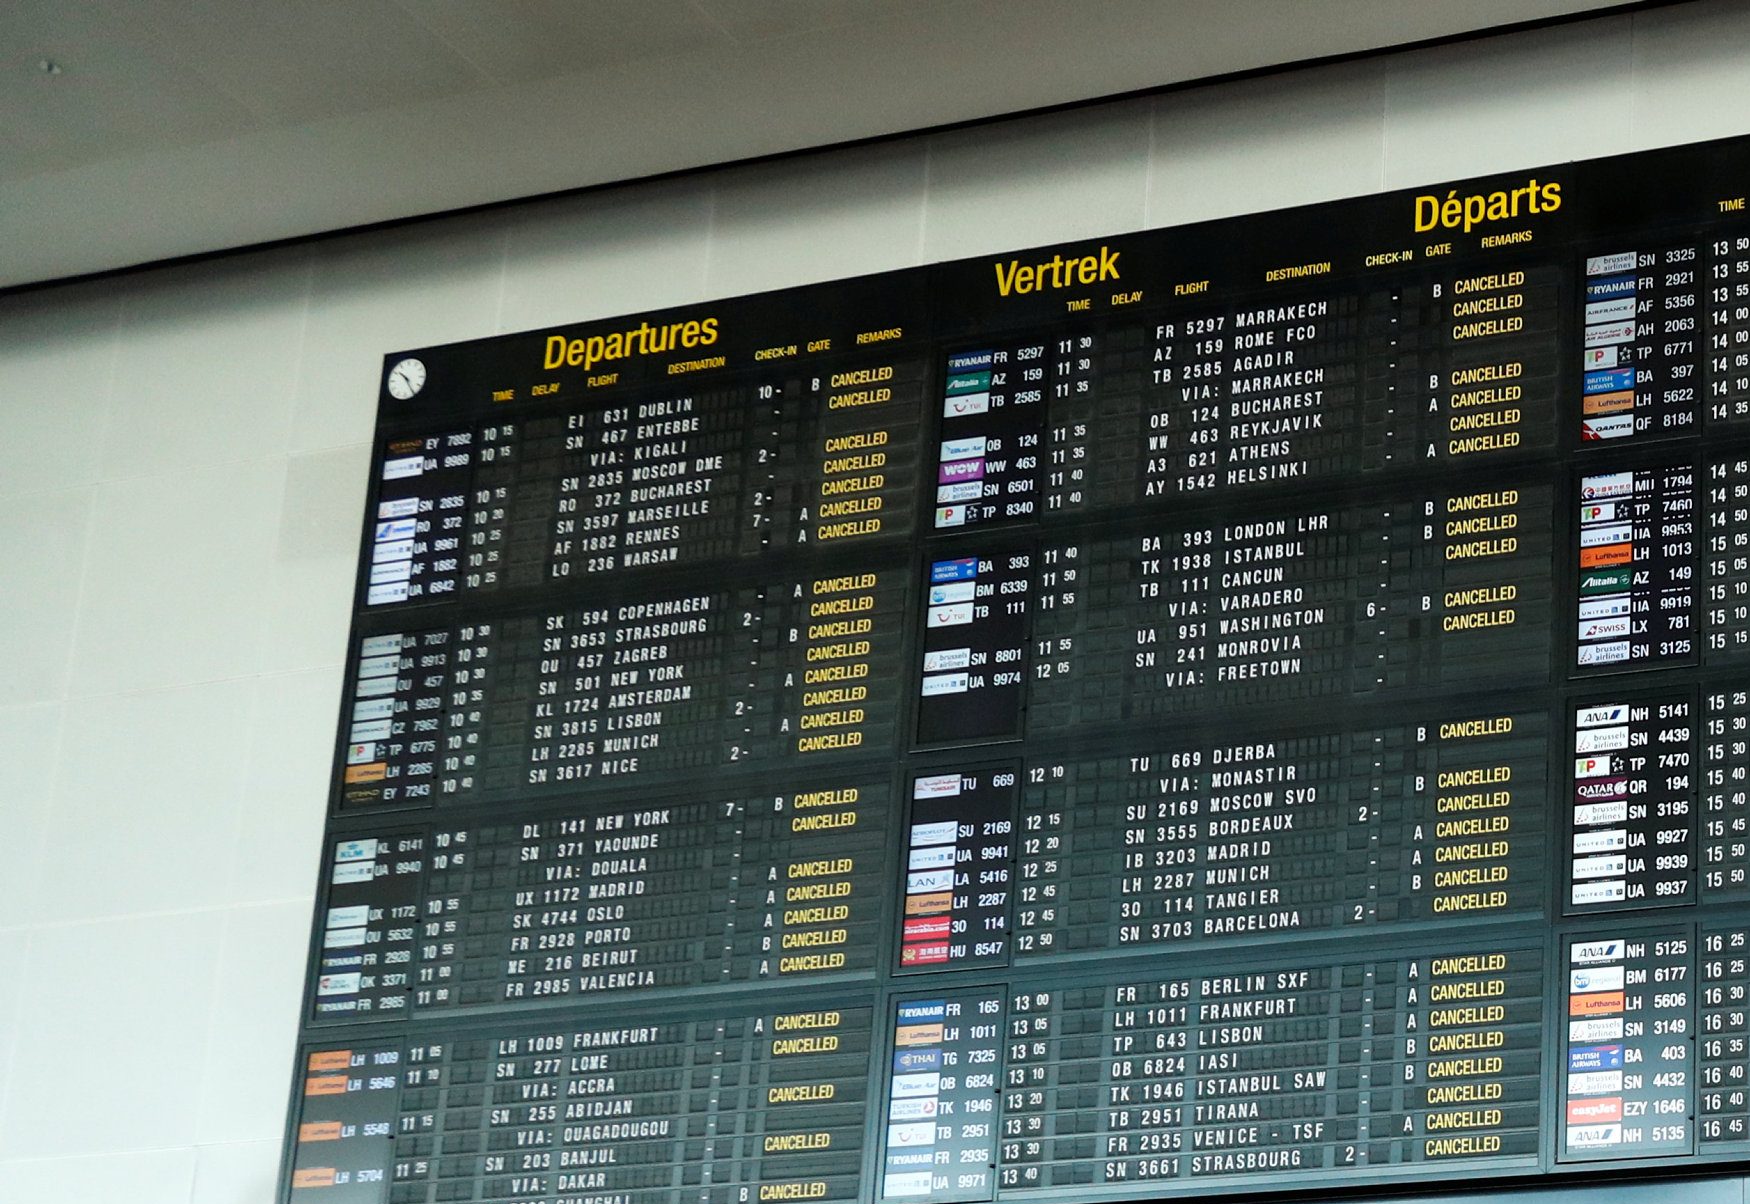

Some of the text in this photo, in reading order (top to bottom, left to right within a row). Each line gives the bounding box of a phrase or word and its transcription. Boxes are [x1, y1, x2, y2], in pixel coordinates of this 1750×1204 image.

[1414, 179, 1562, 233] Départs
[1718, 197, 1745, 213] TIME
[1665, 247, 1696, 264] 3325
[1712, 237, 1750, 256] 13 50
[995, 246, 1121, 297] Vertrek
[1066, 230, 1533, 312] TIME DELAY FLIGHT DESTINATION CHECK-IN GATE REMARKS
[1454, 271, 1525, 295] CANCELLED
[1593, 280, 1636, 295] RYANAIR
[1156, 301, 1327, 340] FR 5297 MARRAKECH
[544, 317, 719, 371] Departures
[1234, 324, 1316, 350] ROME FCO
[587, 372, 619, 388] FLIGHT
[667, 356, 726, 375] DESTINATION
[754, 345, 798, 361] CHECK-IN
[807, 338, 831, 353] GATE
[856, 327, 902, 345] REMARKS
[954, 355, 992, 368] RYANAIR
[830, 366, 893, 388] CANCELLED
[1181, 368, 1324, 402] VIA: MARRAKECH
[638, 398, 693, 419] DUBLIN
[1231, 390, 1323, 417] BUCHAREST
[636, 417, 699, 440] ENTEBBE
[1230, 413, 1322, 440] REYKJAVIK
[1663, 411, 1694, 427] 8184
[1228, 440, 1290, 463] ATHENS
[1227, 460, 1307, 485] HELSINKI
[630, 478, 712, 503] BUCHAREST
[1224, 515, 1328, 542] LONDON LHR
[1225, 541, 1304, 565] ISTANBUL
[618, 596, 710, 621] COPENHAGEN
[1220, 587, 1303, 612] VARADERO
[615, 618, 707, 643] STRASBOURG
[1219, 608, 1324, 635] WASHINGTON
[1598, 622, 1627, 634] SWISS
[1659, 639, 1691, 656] 3125
[1218, 658, 1301, 682] FREETOWN
[607, 711, 662, 731] LISBON
[1439, 717, 1513, 739] CANCELLED
[1213, 743, 1275, 764] DJERBA
[1211, 765, 1296, 788] MONASTIR
[1629, 775, 1689, 794] QR 194
[794, 788, 858, 809] CANCELLED
[1577, 782, 1614, 797] QATAR
[1209, 813, 1293, 837] BORDEAUX
[1204, 910, 1300, 934] BARCELONA
[584, 926, 631, 945] PORTO
[580, 970, 655, 991] VALENCIA
[1201, 971, 1308, 996] BERLIN SXF
[904, 1005, 945, 1017] RYANAIR
[1200, 997, 1296, 1020] FRANKFURT
[573, 1027, 659, 1048] FRANKFURT
[1199, 1025, 1263, 1046] LISBON
[912, 1053, 936, 1064] THAI
[567, 1077, 615, 1095] ACCRA
[964, 1098, 993, 1113] 1946
[563, 1120, 669, 1143] OUAGADOUGOU
[1425, 1135, 1501, 1156] CANCELLED
[1192, 1149, 1301, 1173] STRASBOURG
[759, 1182, 826, 1201] CANCELLED
